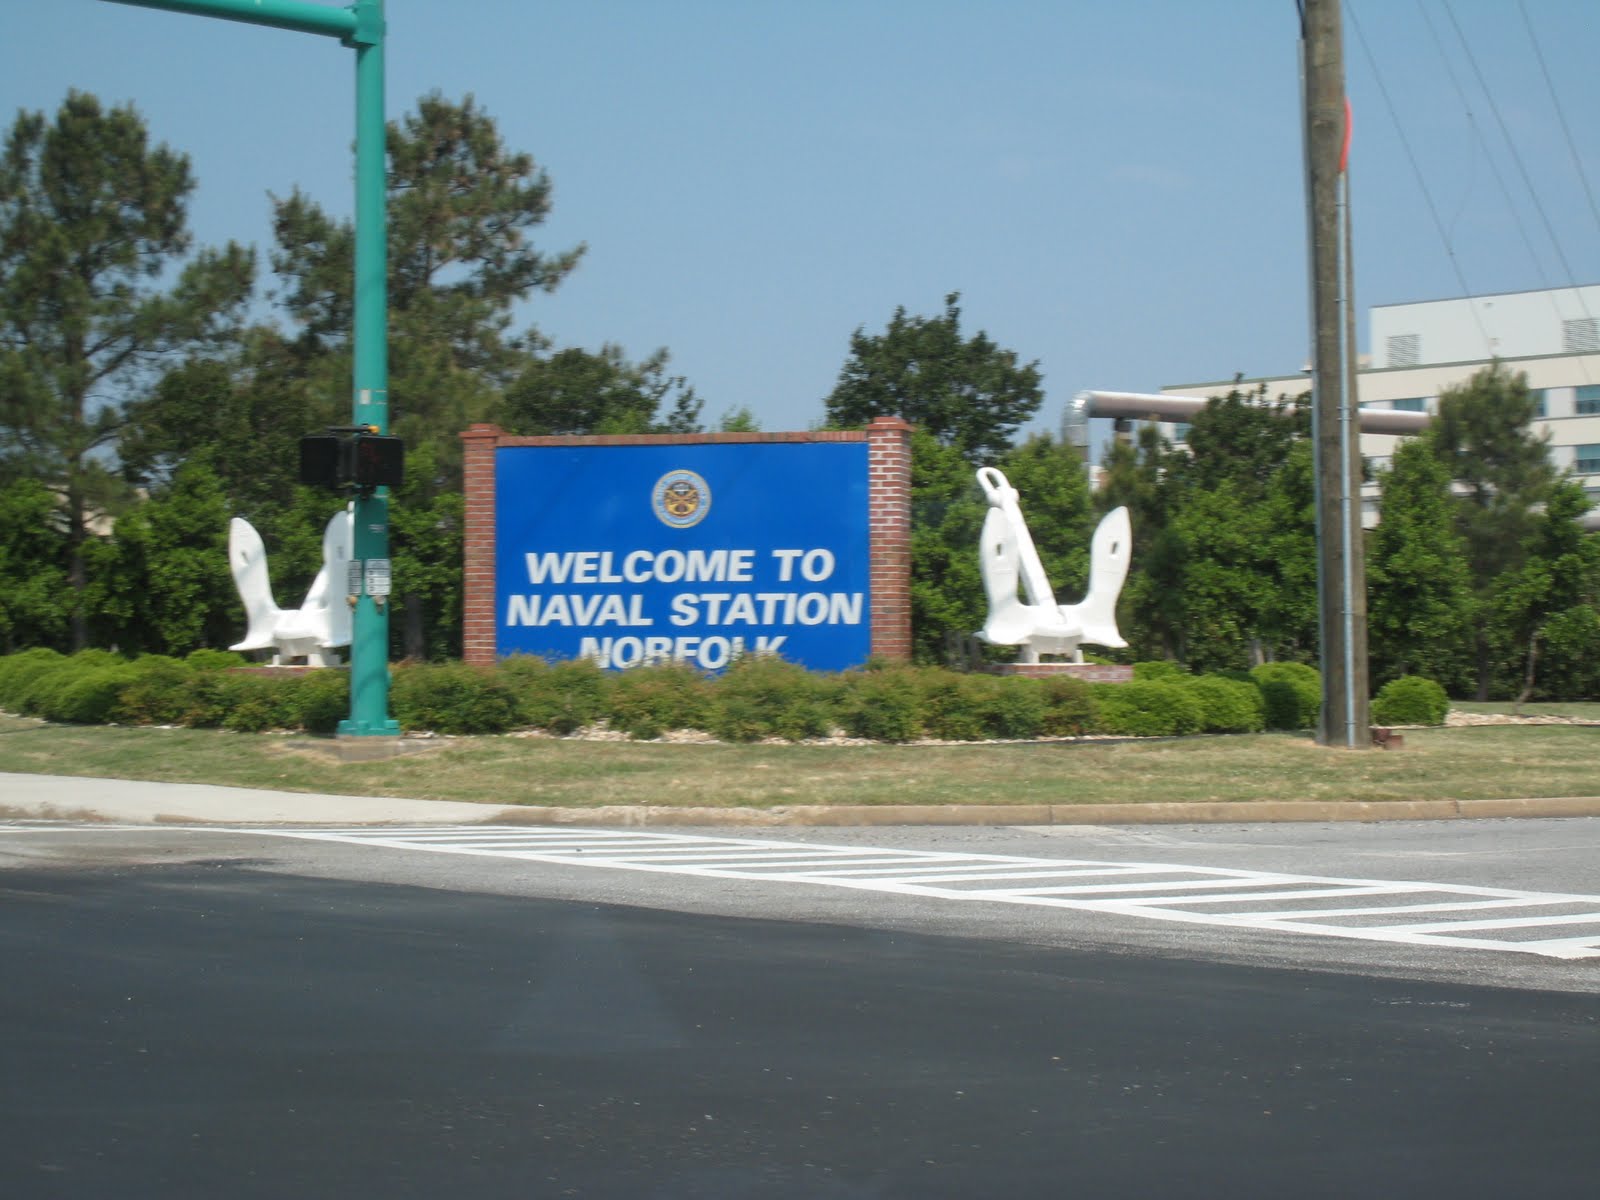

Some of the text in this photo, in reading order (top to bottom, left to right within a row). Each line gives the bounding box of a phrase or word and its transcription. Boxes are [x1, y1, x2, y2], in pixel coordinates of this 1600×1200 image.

[525, 548, 835, 584] WELCOME TO
[506, 592, 863, 627] NAVAL STATION
